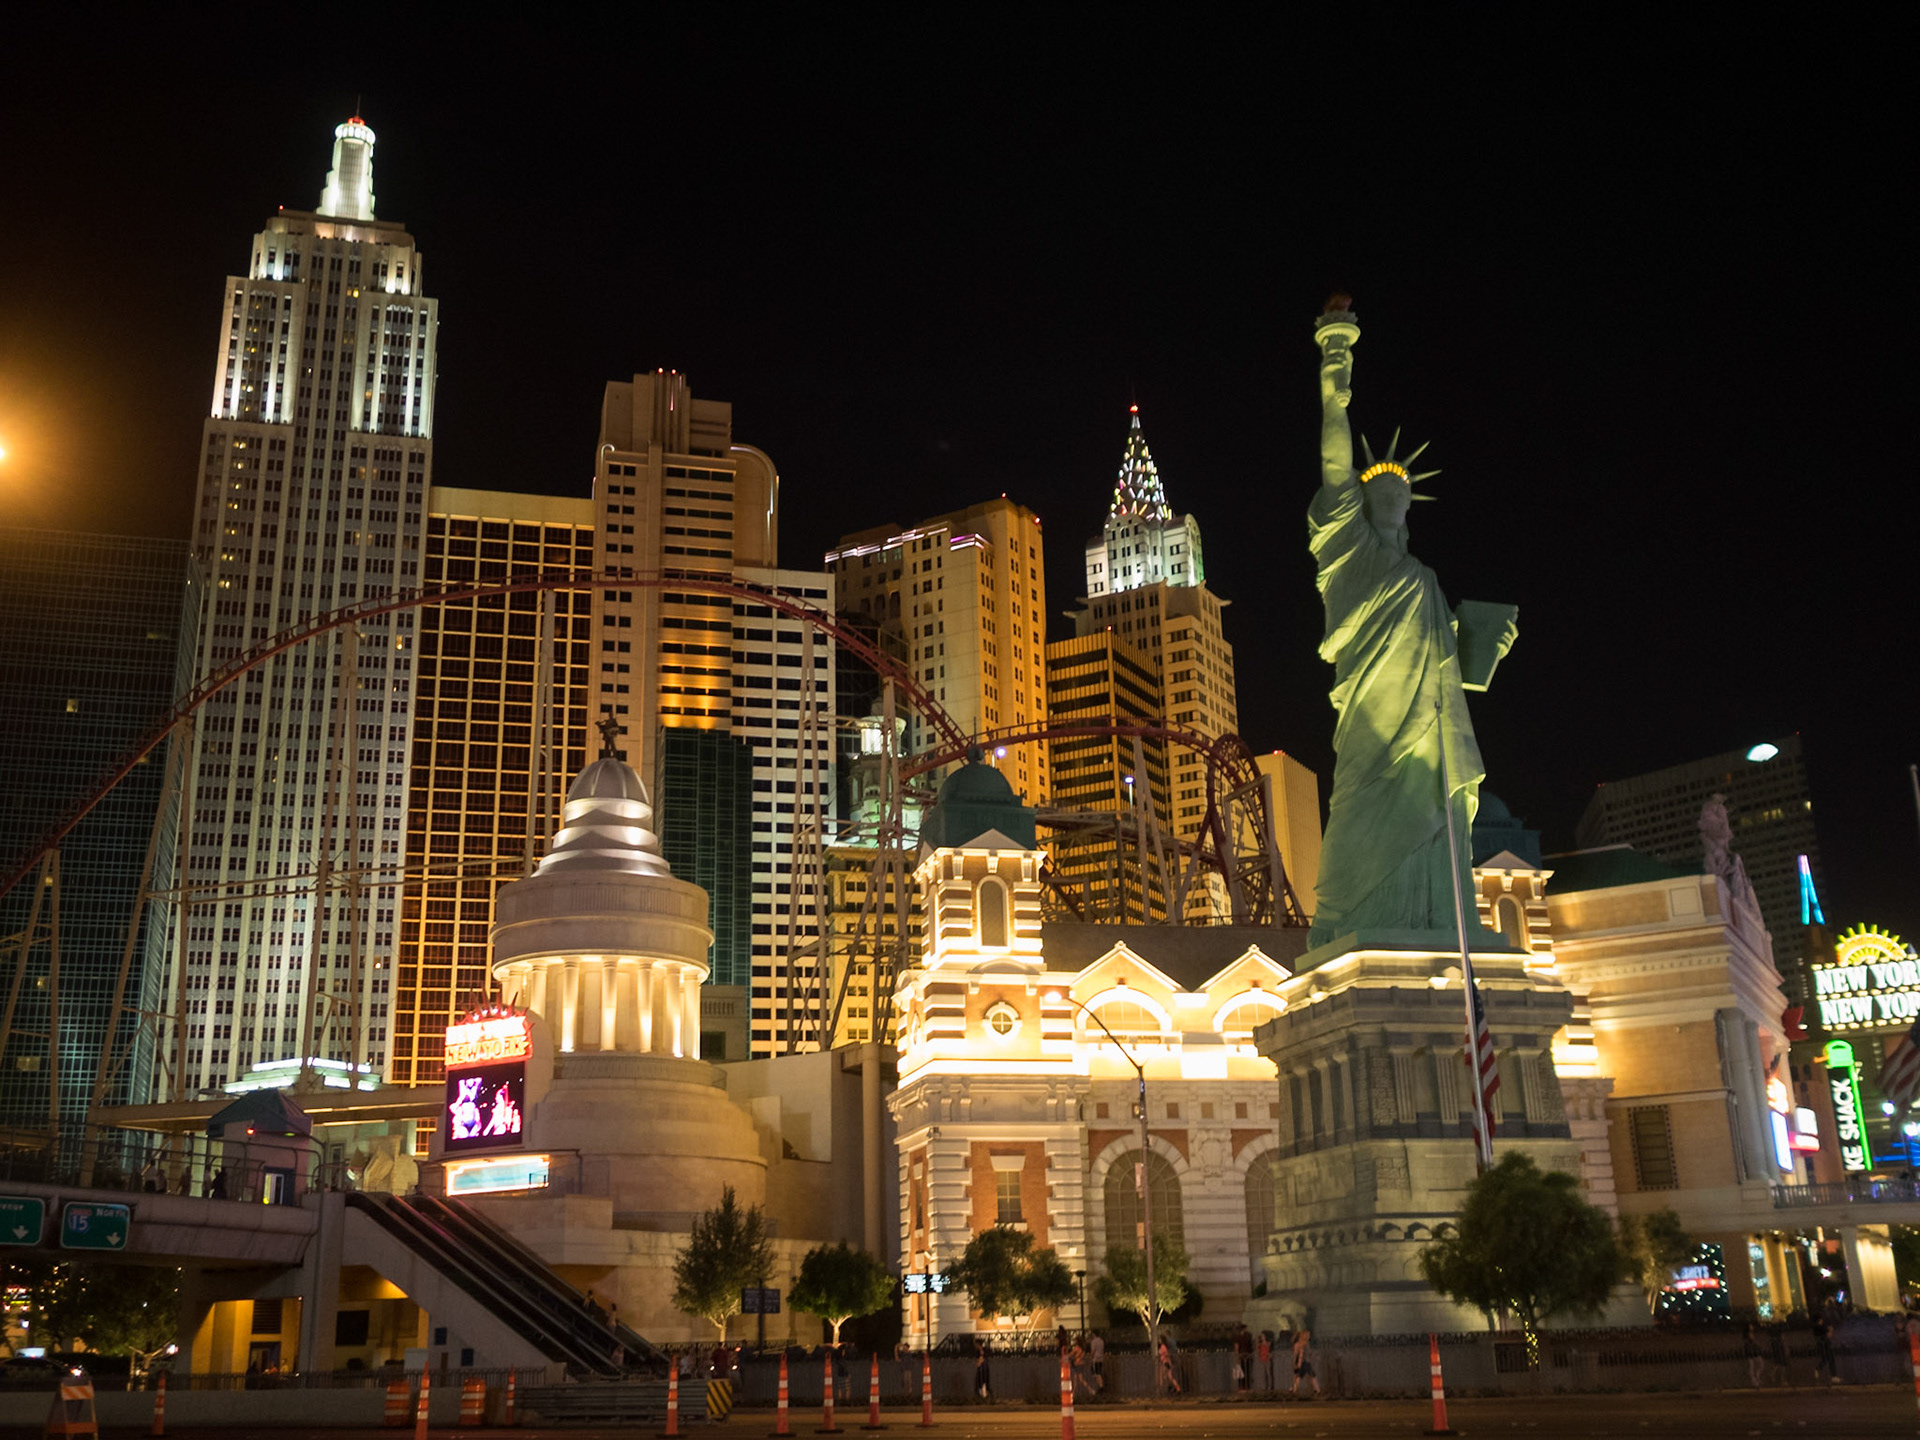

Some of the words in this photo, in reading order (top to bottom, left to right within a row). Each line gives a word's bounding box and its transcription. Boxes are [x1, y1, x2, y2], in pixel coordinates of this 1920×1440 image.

[1814, 965, 1868, 994] NEW
[1869, 959, 1920, 989] YOR
[1819, 996, 1873, 1025] NEW
[1830, 1078, 1860, 1140] SHACK
[72, 1214, 89, 1232] 15
